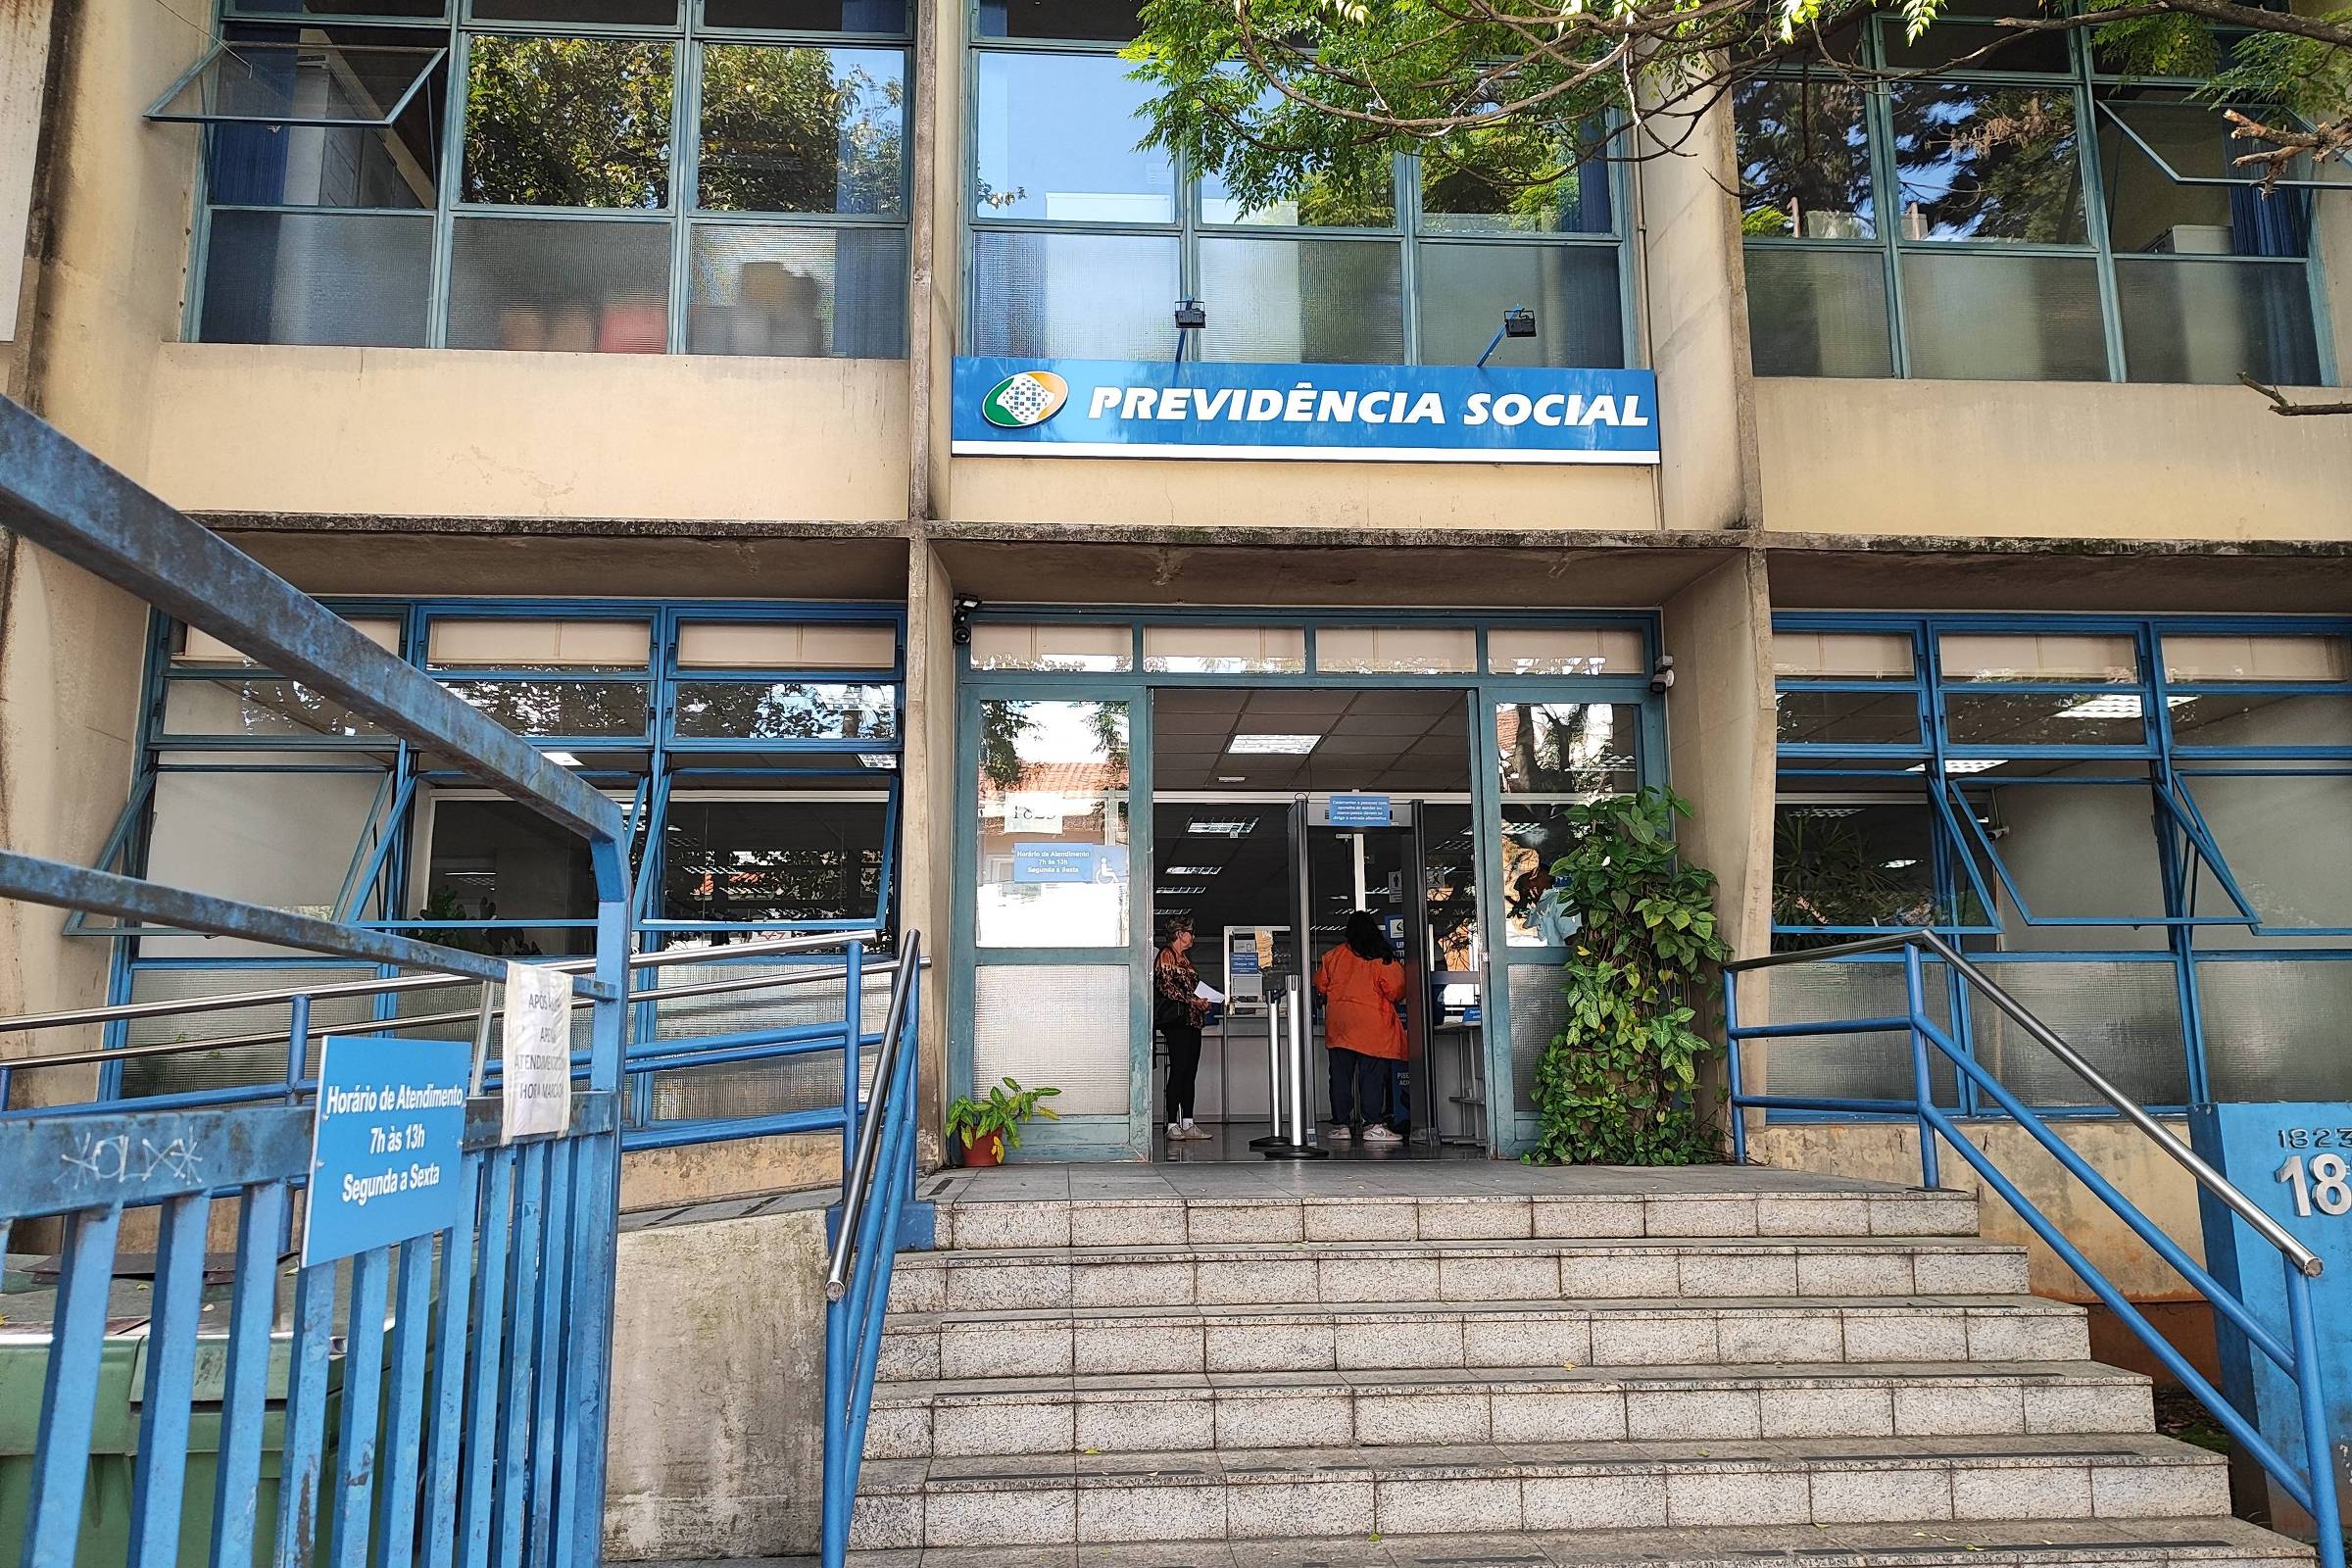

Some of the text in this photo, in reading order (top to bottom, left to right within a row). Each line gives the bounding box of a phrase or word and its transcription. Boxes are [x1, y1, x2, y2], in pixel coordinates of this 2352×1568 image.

[1088, 381, 1648, 426] PREVIDÊNCIA SOCIAL
[326, 1083, 464, 1113] Horário de Atendimento
[369, 1123, 425, 1154] 7h às 13h
[2278, 1128, 2352, 1149] 1823
[342, 1162, 440, 1206] Segunda a Sexta
[2275, 1153, 2352, 1217] 18
